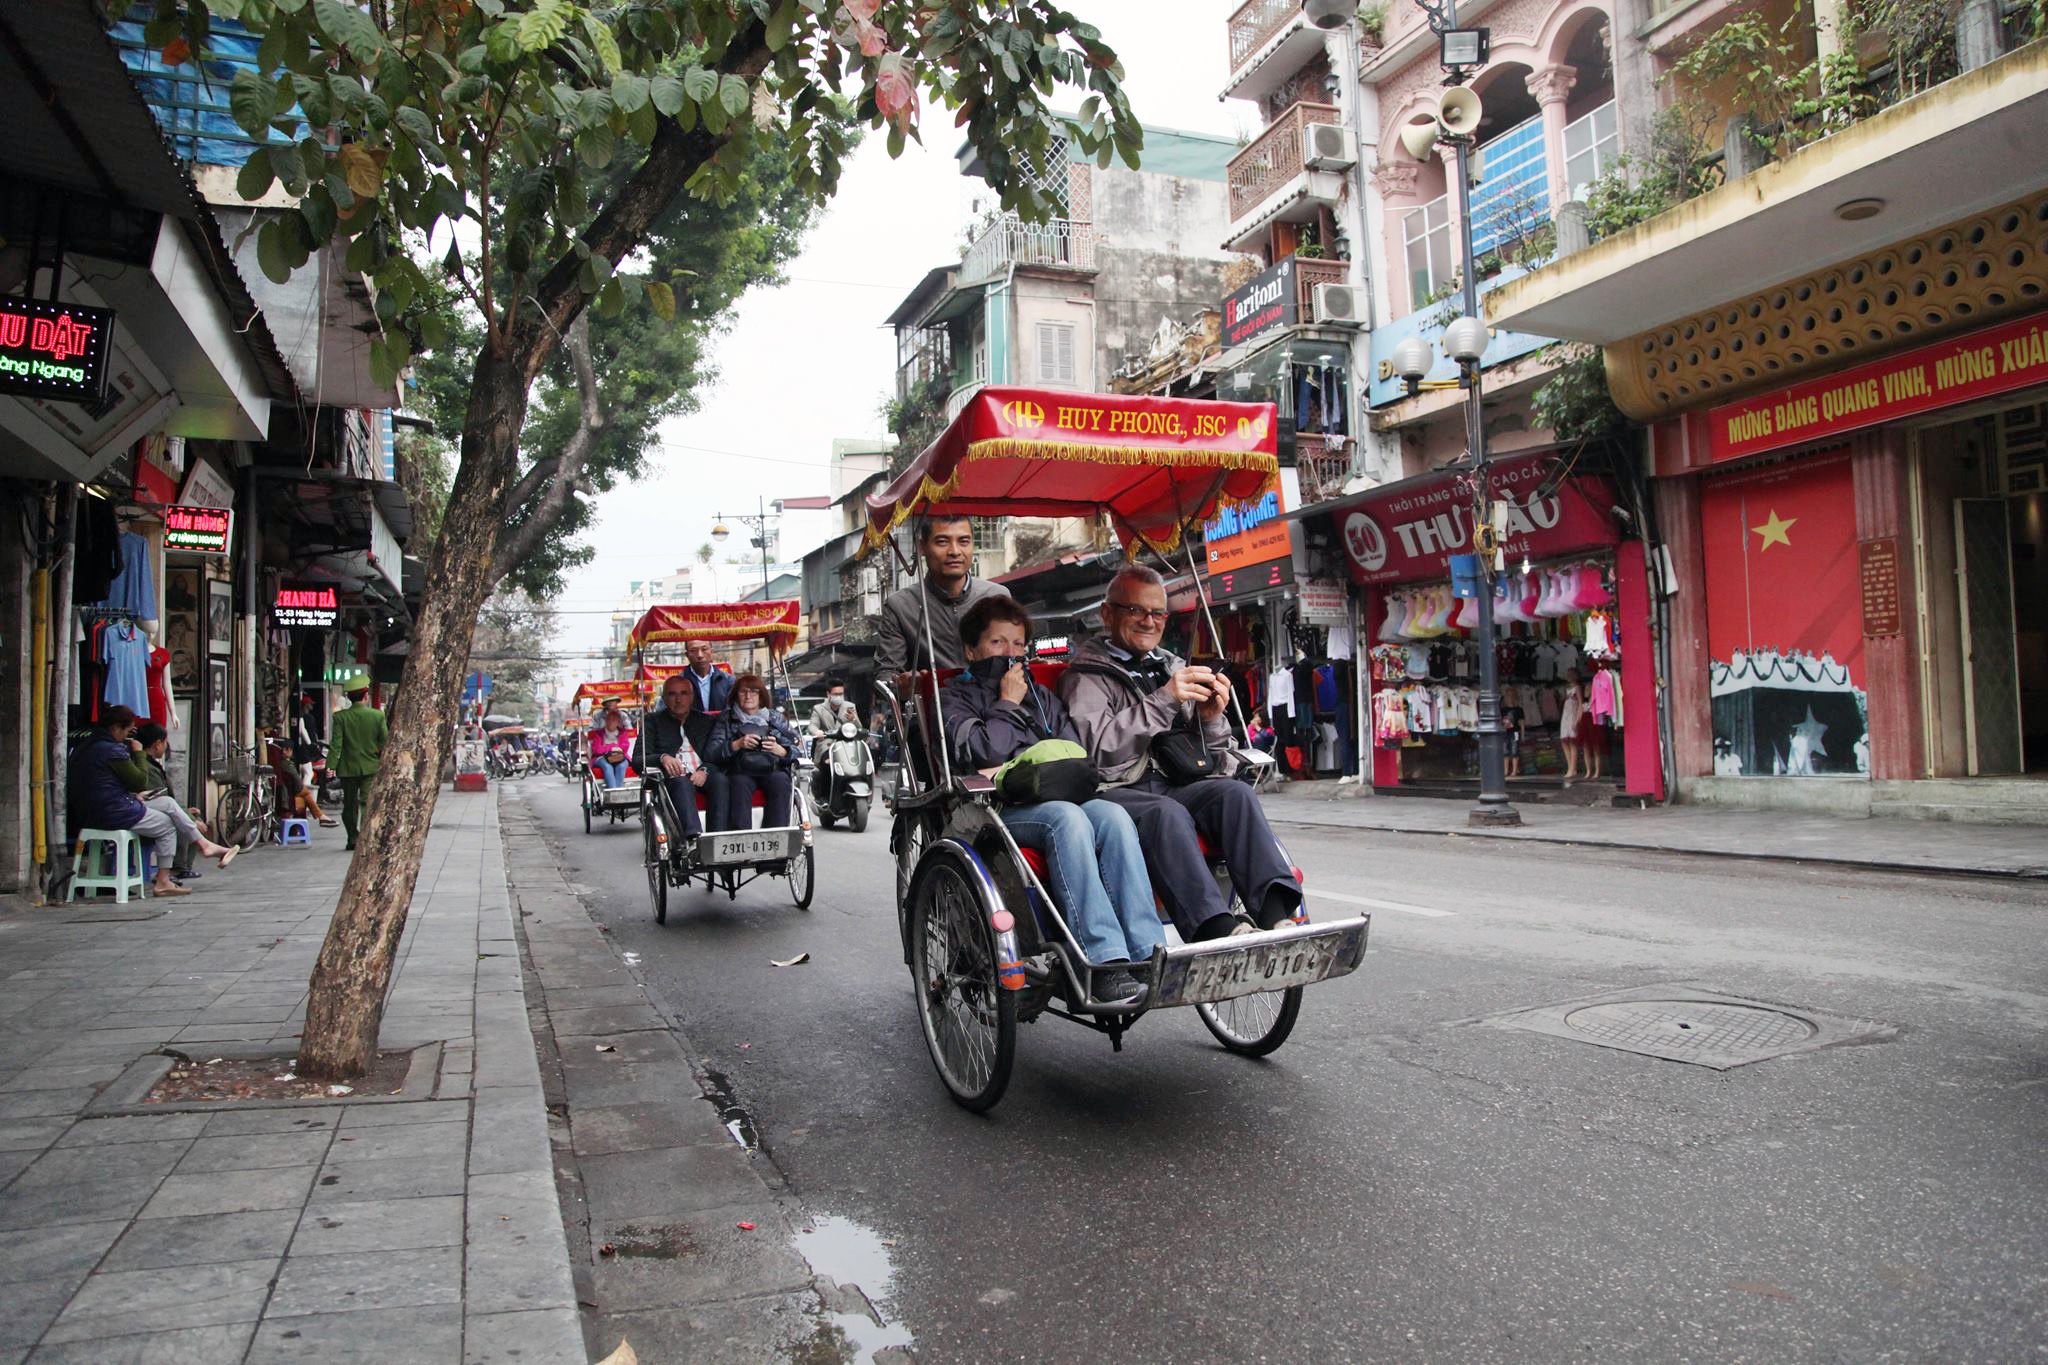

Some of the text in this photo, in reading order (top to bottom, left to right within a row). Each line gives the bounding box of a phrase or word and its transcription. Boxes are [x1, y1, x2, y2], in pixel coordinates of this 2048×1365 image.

[30, 315, 92, 360] DẬT
[32, 360, 84, 383] Ngang
[1728, 407, 1772, 445] MỪNG
[1775, 390, 1818, 433] ĐẢNG
[1822, 379, 1879, 421] QUANG
[1882, 365, 1933, 404] VINH,
[1935, 347, 1996, 391] MỪNG
[1057, 406, 1104, 431] HUY
[1192, 415, 1226, 437] JSC
[1388, 496, 1413, 515] THỜI
[1414, 490, 1450, 509] TRANG
[1491, 473, 1519, 487] CAO
[1523, 462, 1546, 480] CẤ
[1347, 523, 1381, 560] 50
[1393, 504, 1467, 558] THƯ
[318, 587, 337, 608] HÀ
[689, 612, 712, 623] HUY
